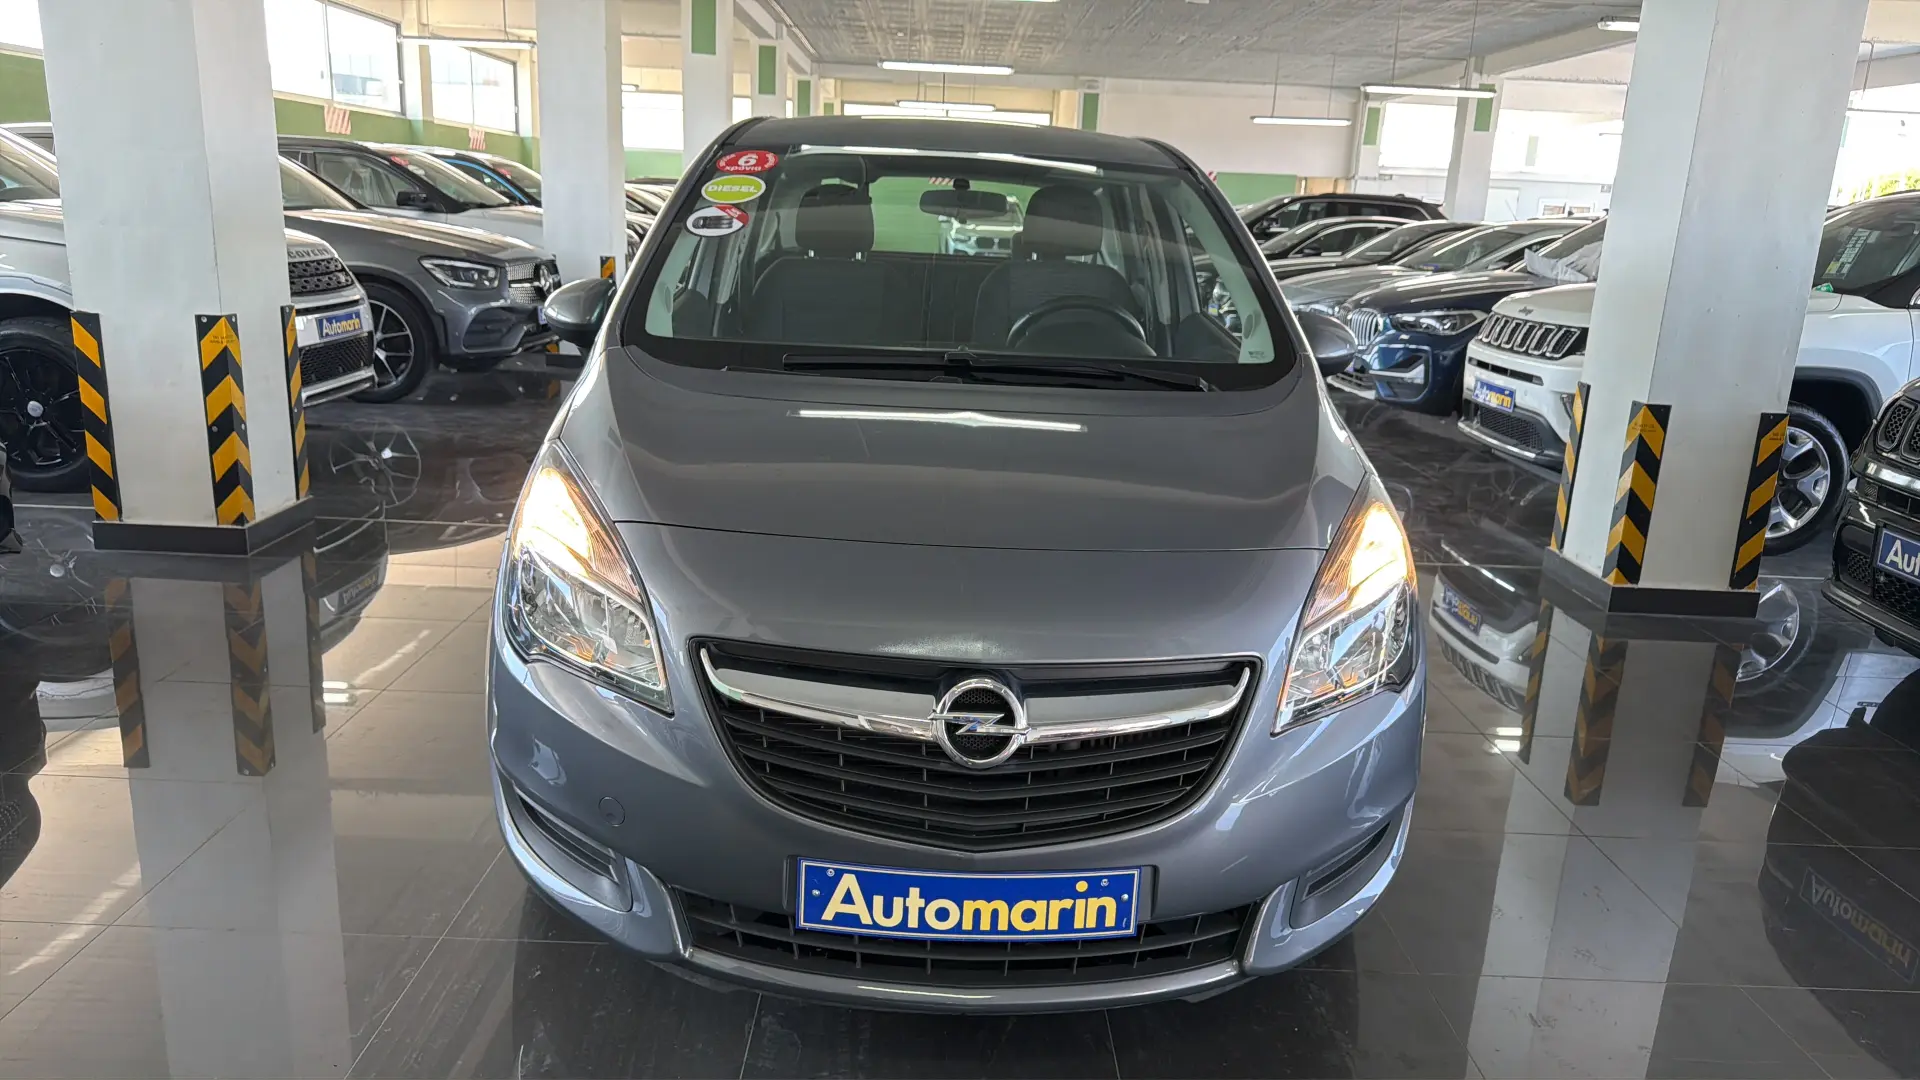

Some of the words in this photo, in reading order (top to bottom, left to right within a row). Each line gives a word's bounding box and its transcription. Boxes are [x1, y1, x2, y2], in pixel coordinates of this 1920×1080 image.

[738, 154, 758, 166] 6
[708, 184, 758, 193] DIESEL
[322, 313, 361, 337] Automarin
[821, 873, 1118, 931] Automarin
